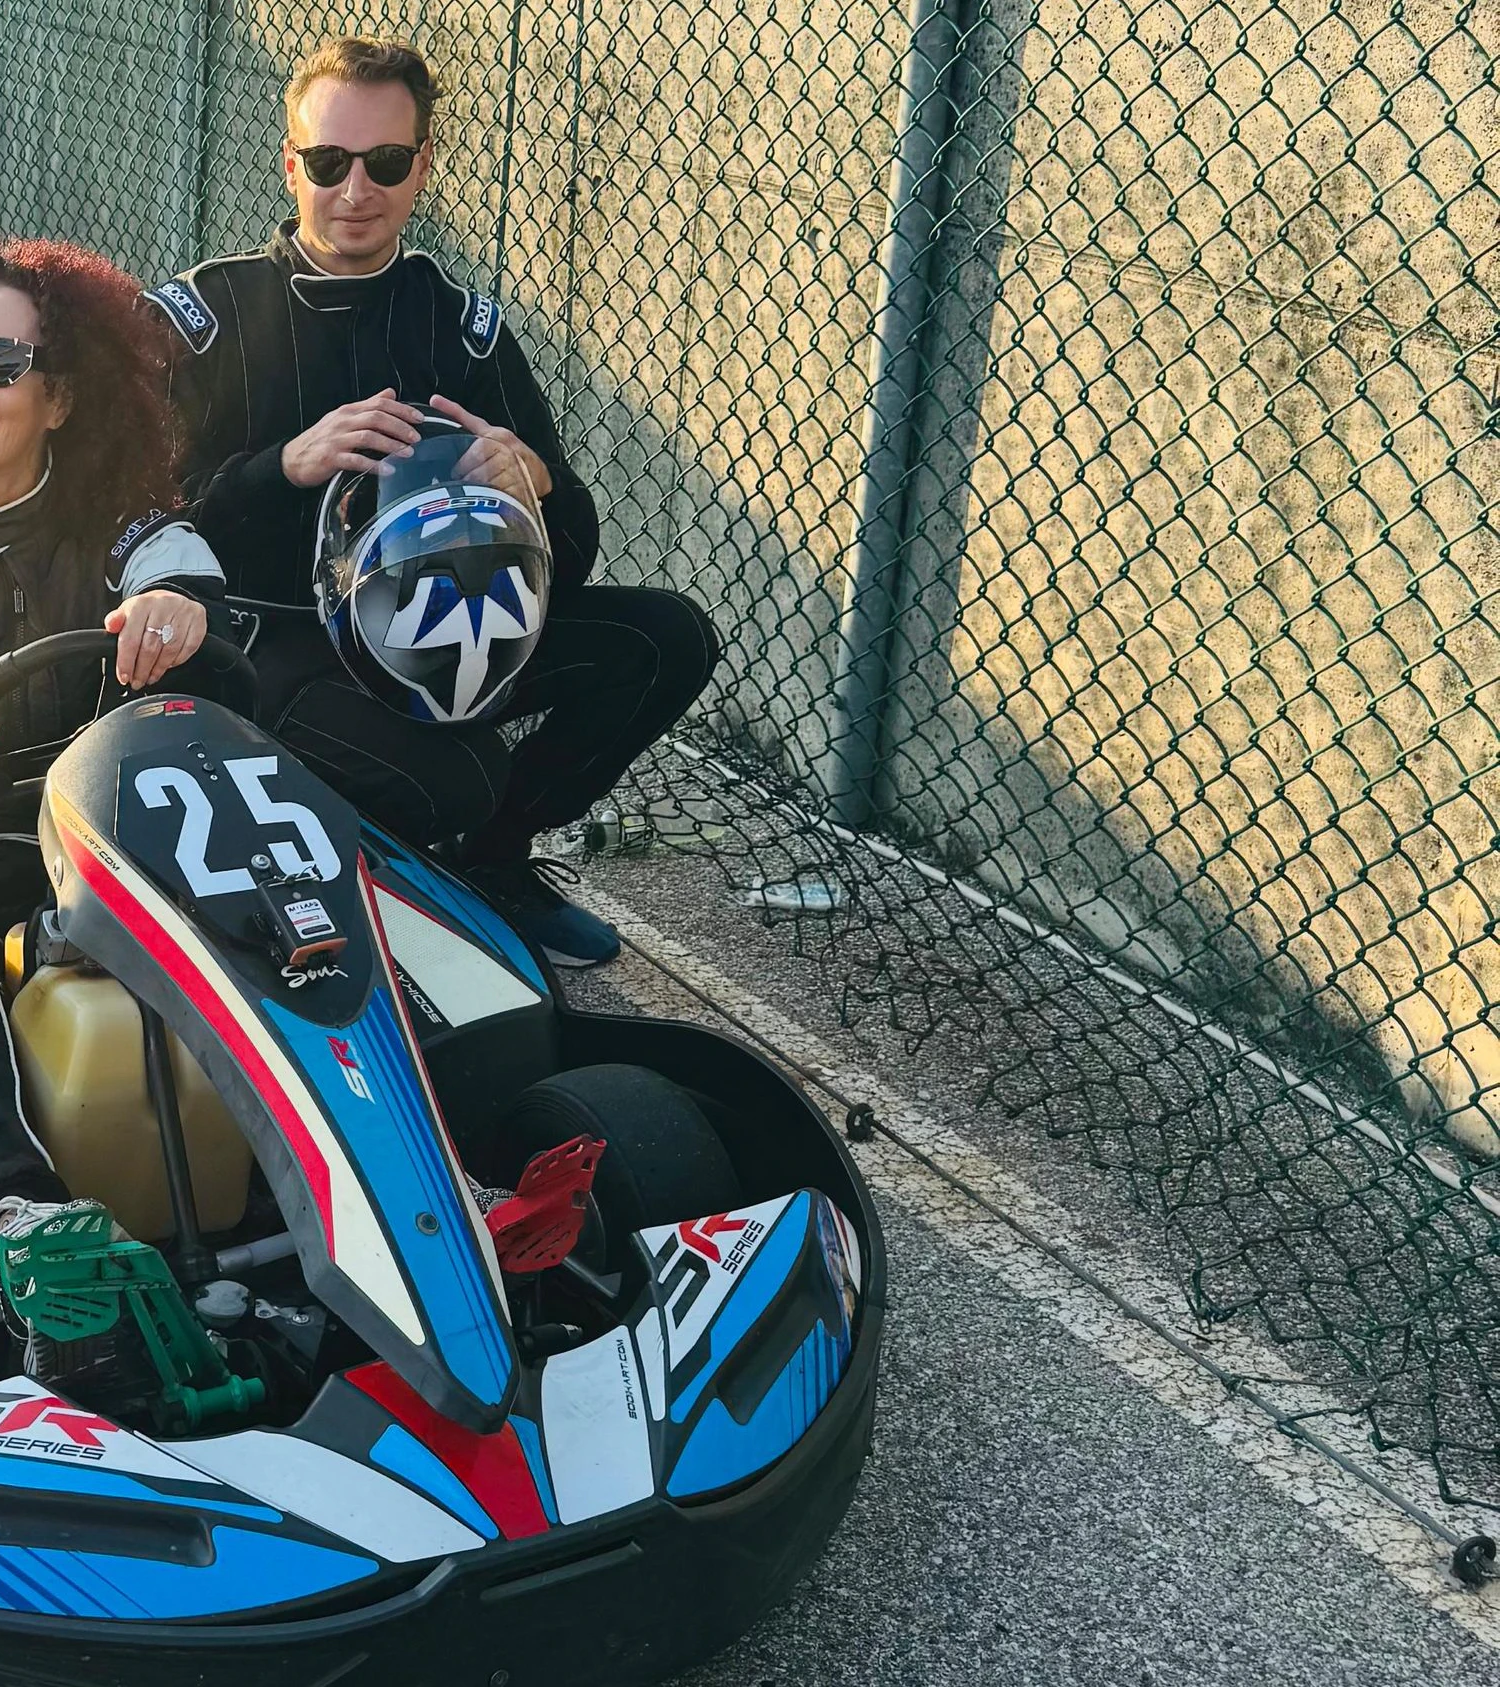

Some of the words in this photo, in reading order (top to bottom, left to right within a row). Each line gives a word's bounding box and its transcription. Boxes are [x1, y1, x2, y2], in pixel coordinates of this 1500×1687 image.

[159, 283, 206, 329] sparco
[135, 756, 341, 897] 25
[721, 1219, 765, 1275] SERIES
